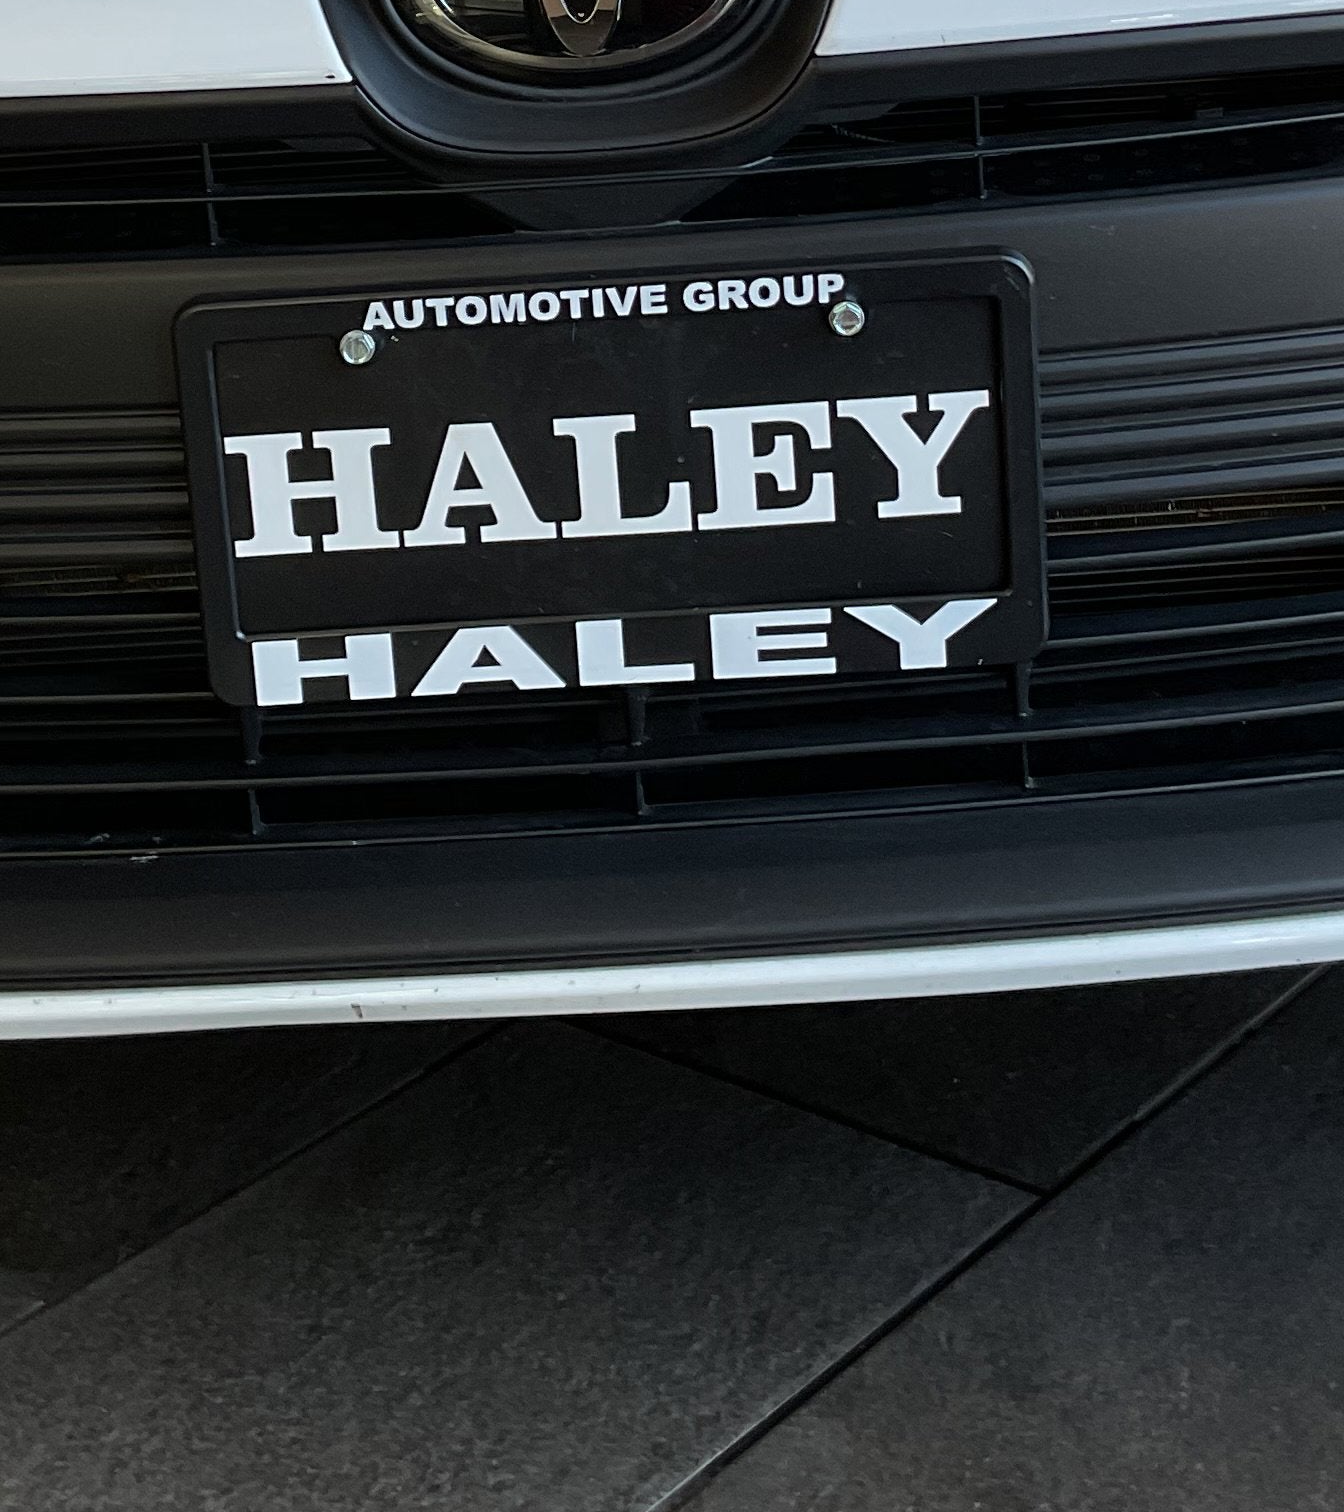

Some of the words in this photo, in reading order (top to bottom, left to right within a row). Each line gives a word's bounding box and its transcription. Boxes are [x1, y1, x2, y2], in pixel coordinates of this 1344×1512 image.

[362, 284, 668, 331] AUTOMOTIVE
[682, 273, 846, 312] GROUP
[223, 389, 990, 558] HALEY
[251, 598, 998, 707] HALEY
